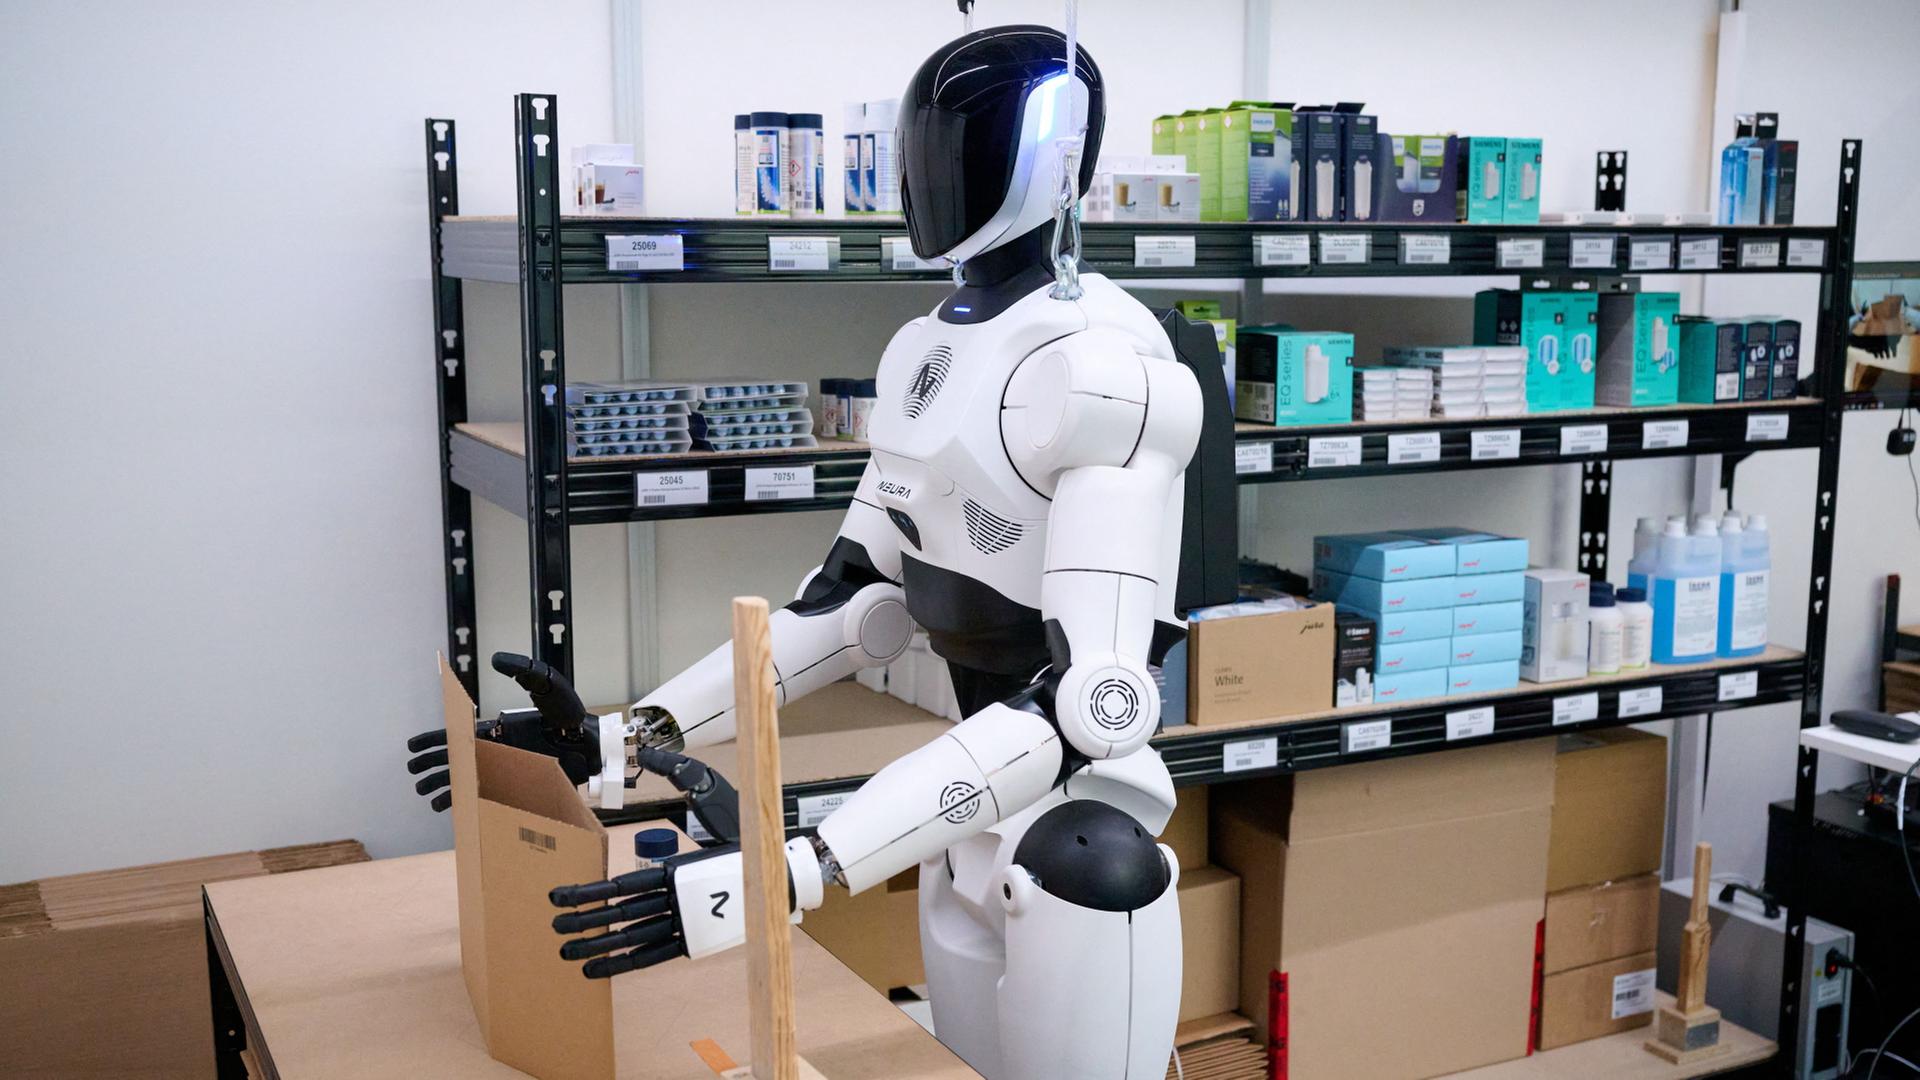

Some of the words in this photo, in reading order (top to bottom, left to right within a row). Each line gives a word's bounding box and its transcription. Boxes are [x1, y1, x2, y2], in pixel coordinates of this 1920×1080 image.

[632, 240, 657, 251] 25069
[1282, 340, 1292, 380] series
[1280, 384, 1292, 406] EQ
[660, 475, 684, 485] 25045
[773, 472, 795, 481] 70751
[876, 480, 911, 499] NEURA
[1214, 674, 1244, 687] White
